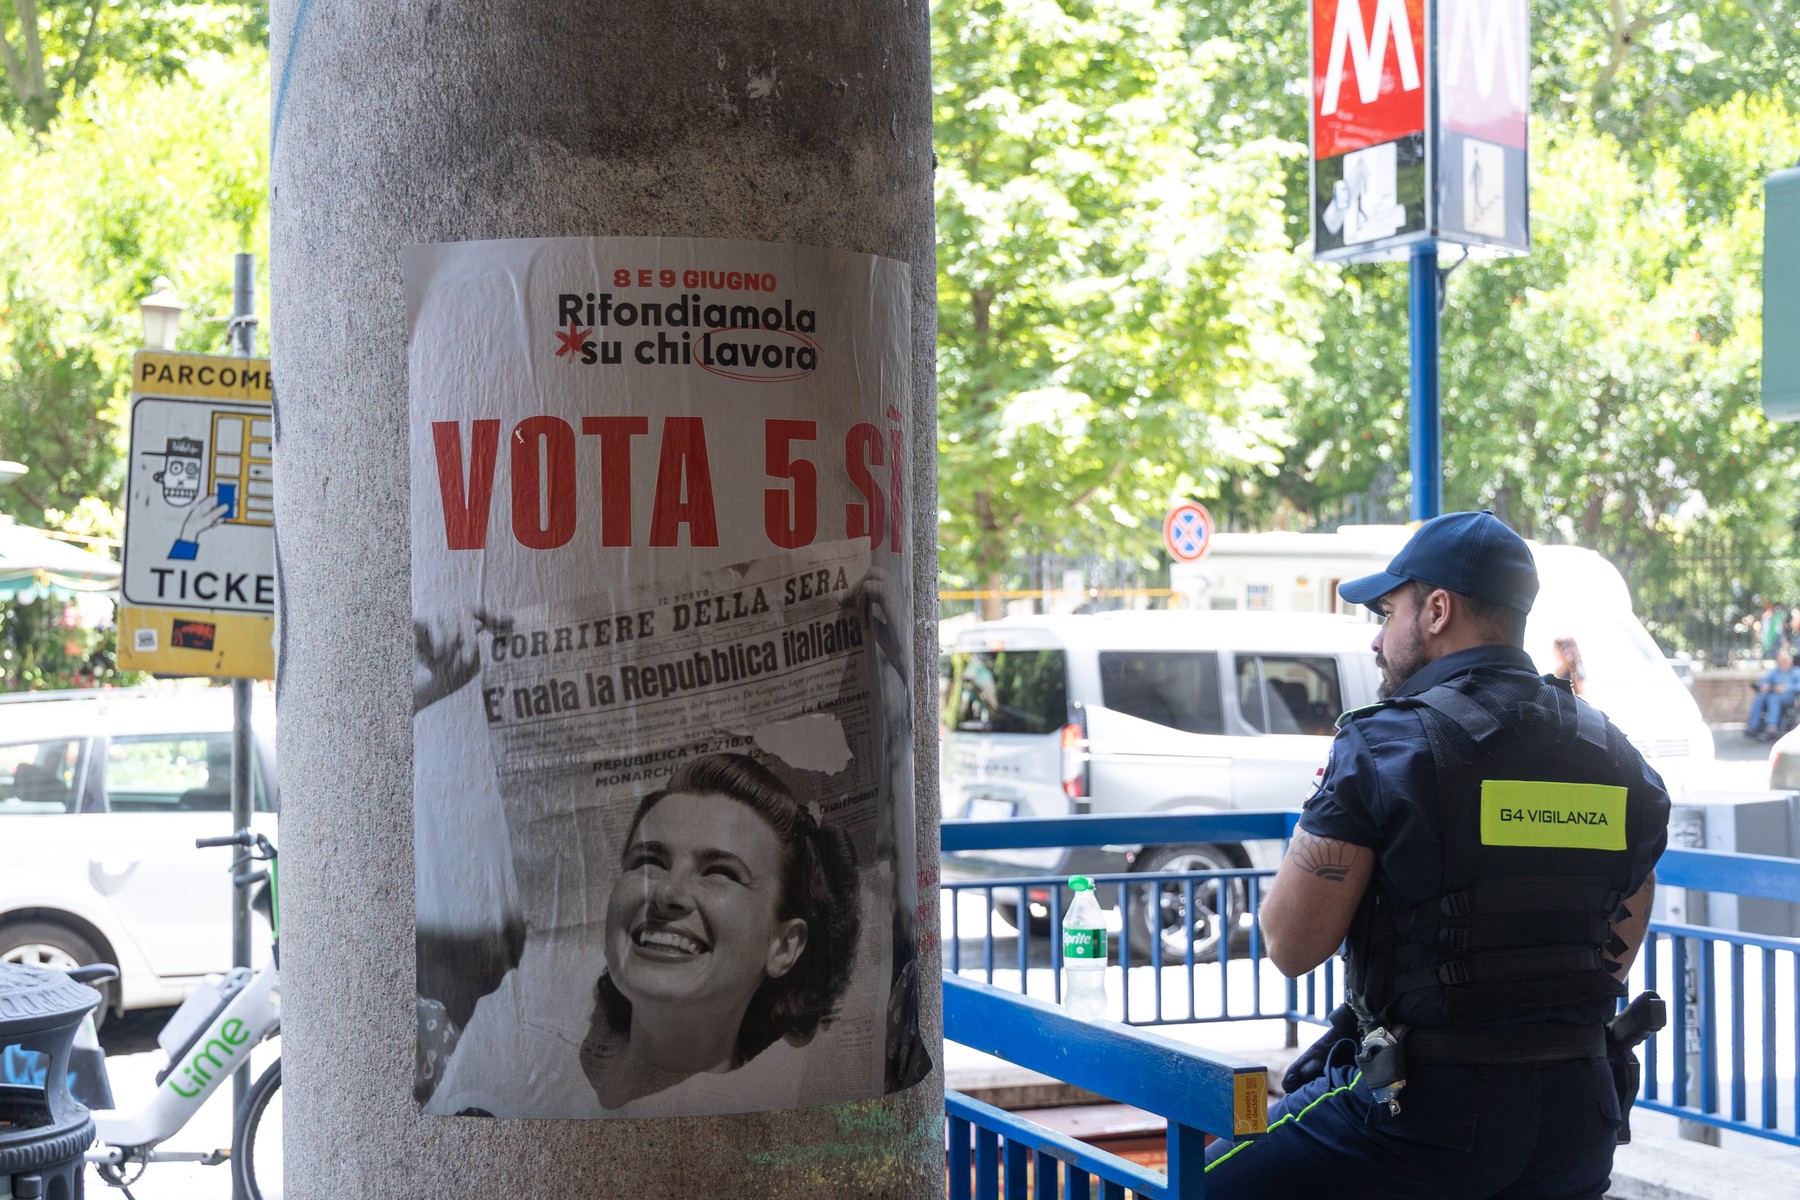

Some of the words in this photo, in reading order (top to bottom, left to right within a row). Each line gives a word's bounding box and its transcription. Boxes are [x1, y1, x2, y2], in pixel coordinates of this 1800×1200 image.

[1320, 0, 1421, 117] M
[613, 268, 631, 288] 8
[637, 269, 652, 288] E
[658, 269, 676, 288] 9
[682, 269, 777, 293] GIUGNO
[558, 292, 816, 334] Rifondiamola
[580, 339, 623, 366] su
[634, 331, 691, 366] chi
[431, 414, 720, 551] VOTA
[763, 418, 817, 550] 5
[150, 567, 274, 604] TICKE
[490, 609, 656, 663] CORRIERE
[672, 586, 770, 633] DELLA
[783, 566, 850, 607] SERA
[512, 678, 581, 719] nata
[584, 671, 617, 707] la
[619, 640, 779, 700] Repubblica
[781, 615, 864, 669] italiana
[591, 746, 688, 774] REPUBBLICA
[1500, 808, 1525, 822] G4
[1527, 809, 1609, 826] VIGILANZA
